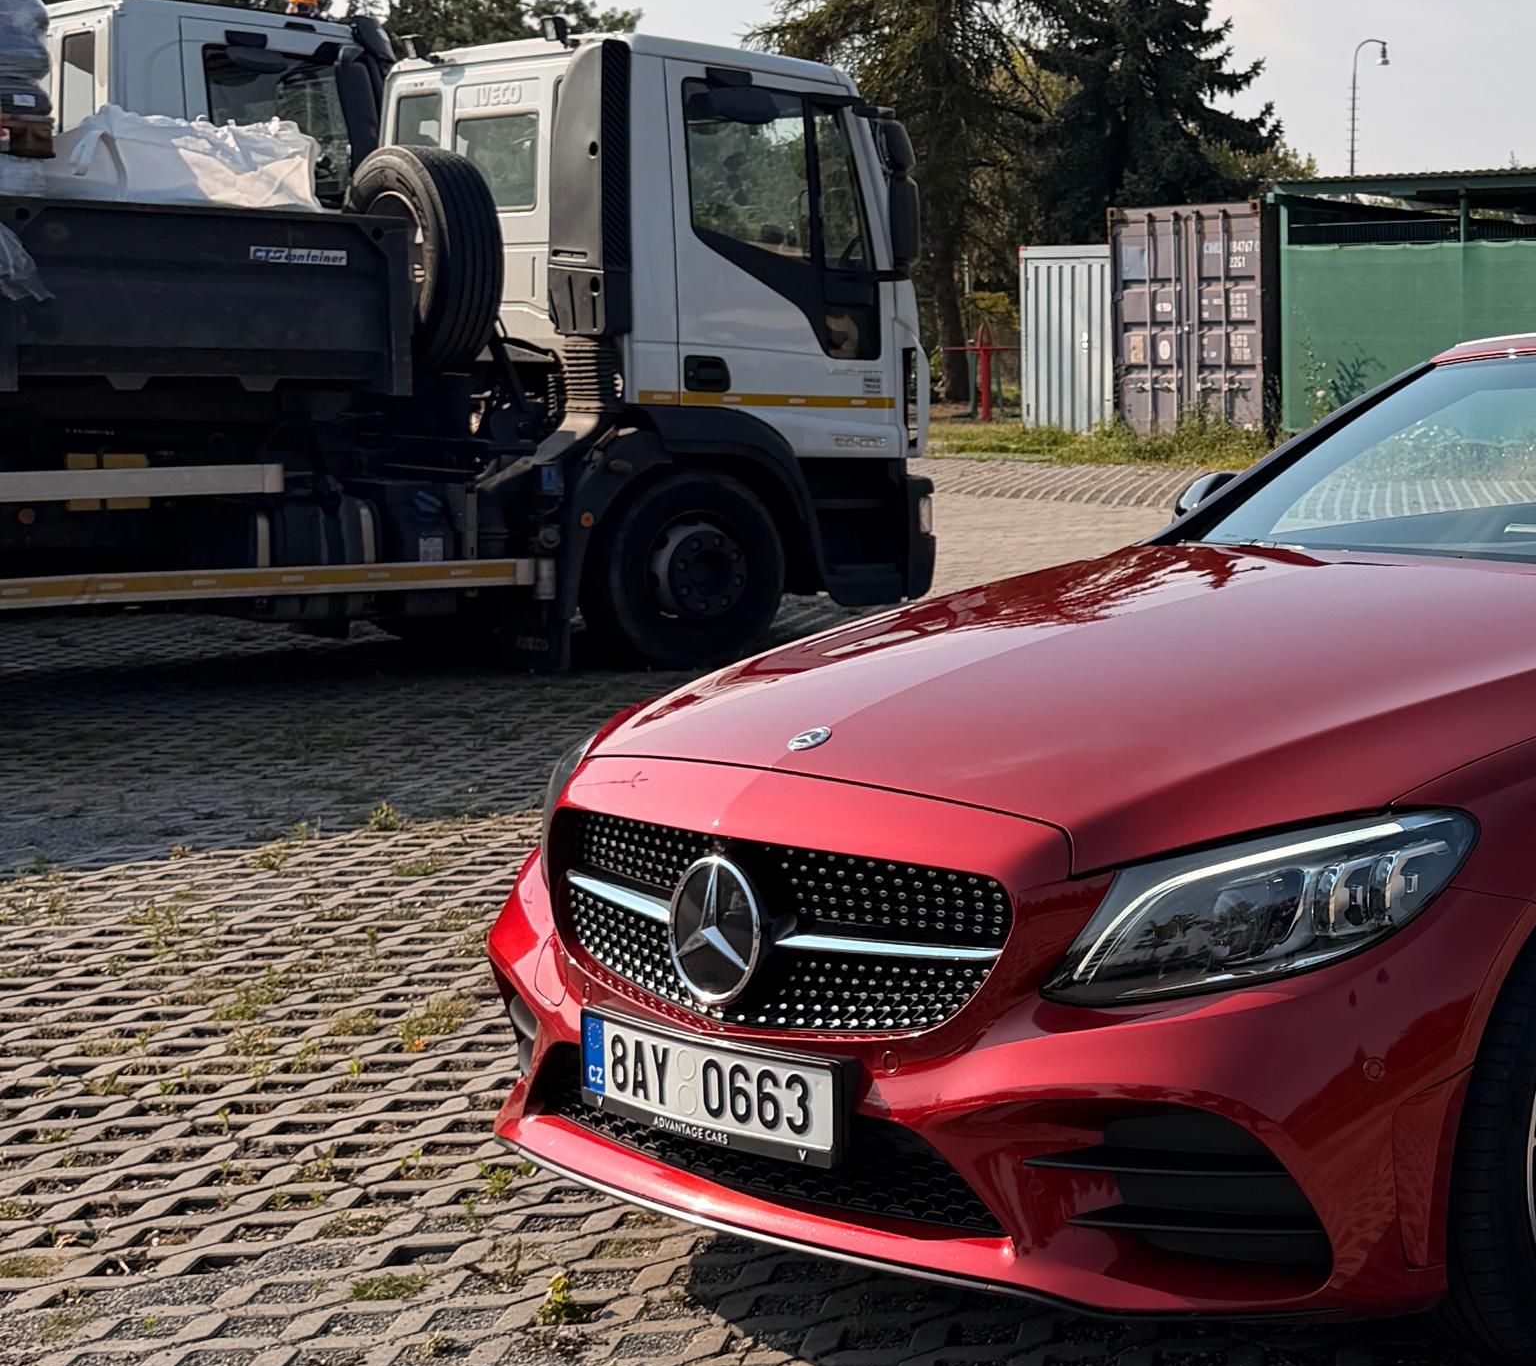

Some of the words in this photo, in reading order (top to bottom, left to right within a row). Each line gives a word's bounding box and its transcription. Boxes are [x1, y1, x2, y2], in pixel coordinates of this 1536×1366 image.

[475, 83, 522, 108] IVECO
[588, 1064, 604, 1084] CZ
[611, 1033, 671, 1106] 8AY
[702, 1058, 810, 1136] 0663
[653, 1116, 704, 1140] ADVANTAGE
[705, 1130, 729, 1146] CARS
